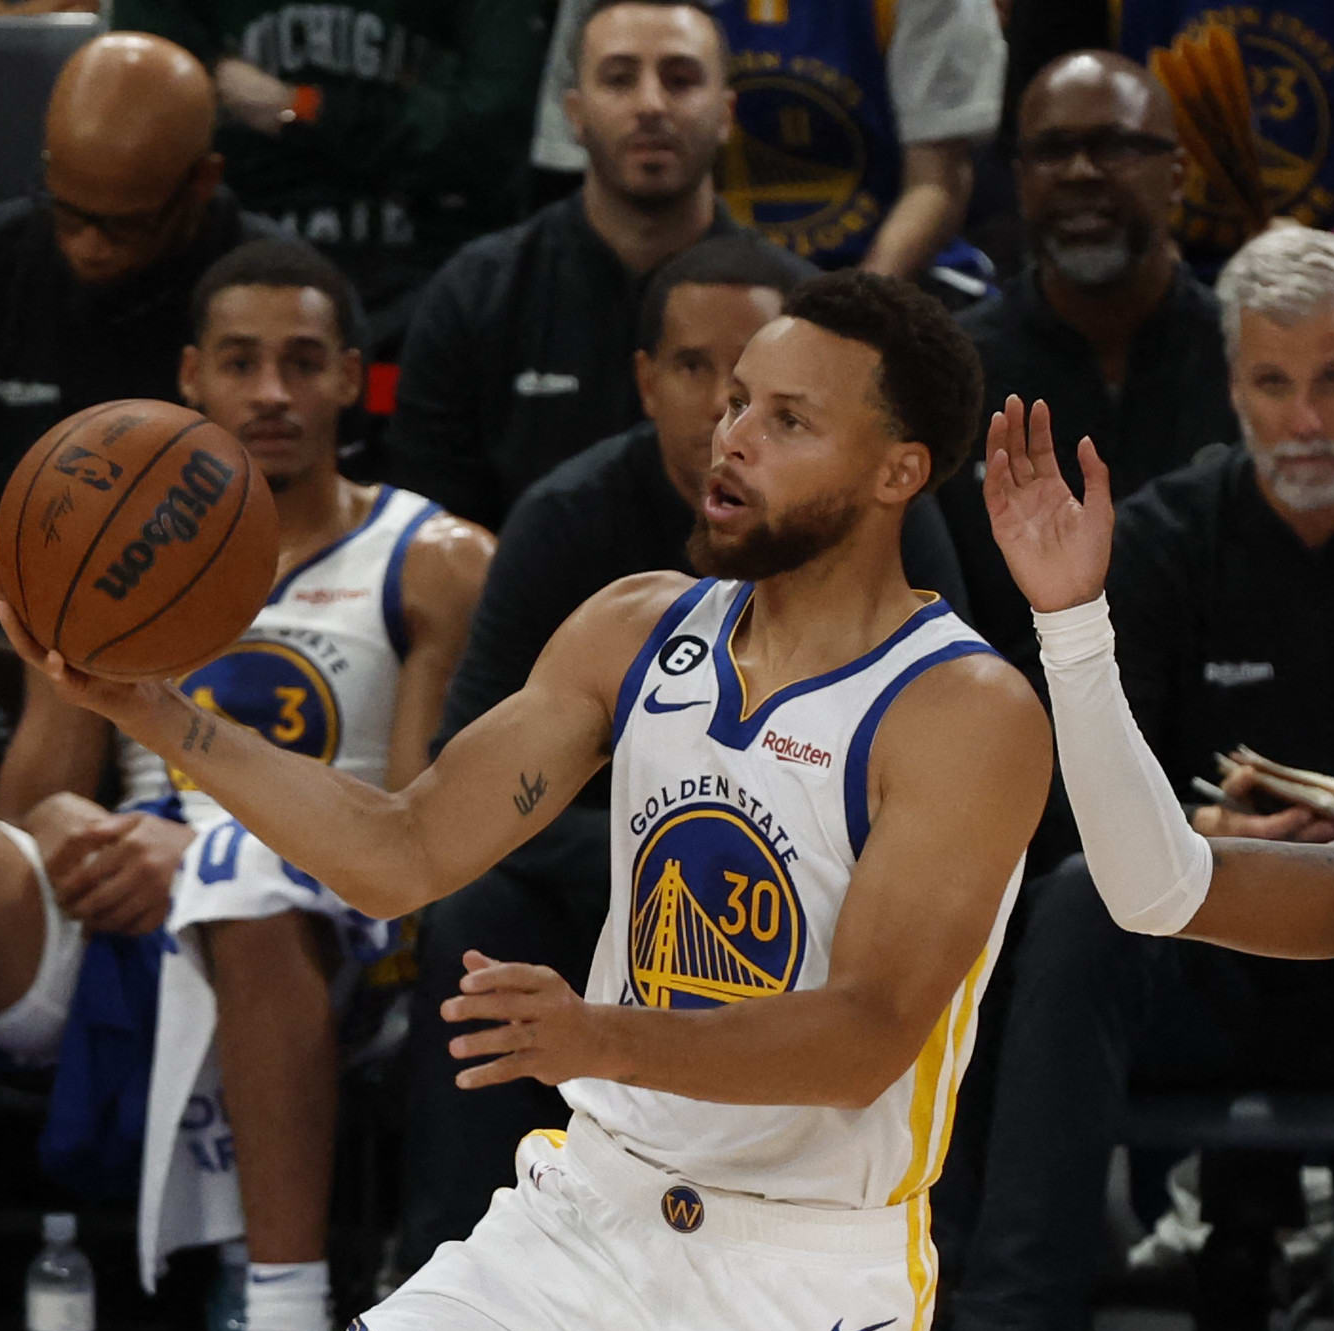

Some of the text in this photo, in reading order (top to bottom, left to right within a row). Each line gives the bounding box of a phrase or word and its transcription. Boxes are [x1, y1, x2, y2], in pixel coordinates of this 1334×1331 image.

[93, 449, 235, 601] Wilson
[667, 641, 702, 673] 6
[273, 686, 307, 742] 3
[762, 730, 832, 768] Rakuten
[631, 775, 799, 869] GOLDEN STATE
[719, 870, 780, 942] 30
[666, 1193, 702, 1228] W
